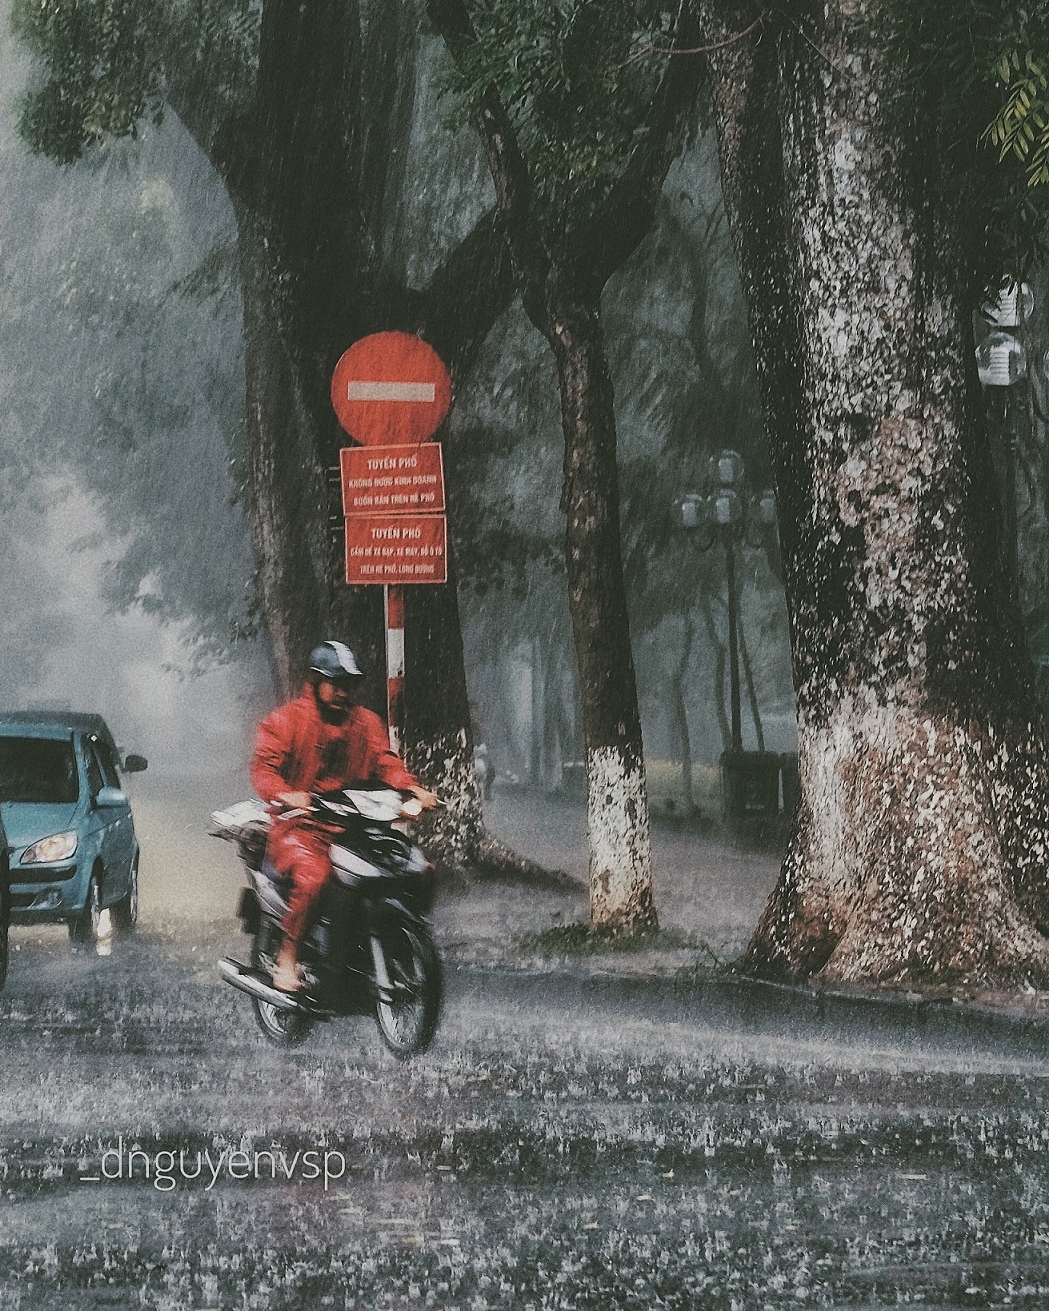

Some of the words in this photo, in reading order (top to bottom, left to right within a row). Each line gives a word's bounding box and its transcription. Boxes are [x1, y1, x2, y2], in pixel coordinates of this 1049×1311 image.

[367, 455, 396, 470] TUYẾN
[398, 453, 418, 468] PHỐ
[371, 525, 400, 539] TUYẾN
[402, 523, 422, 539] PHỐ
